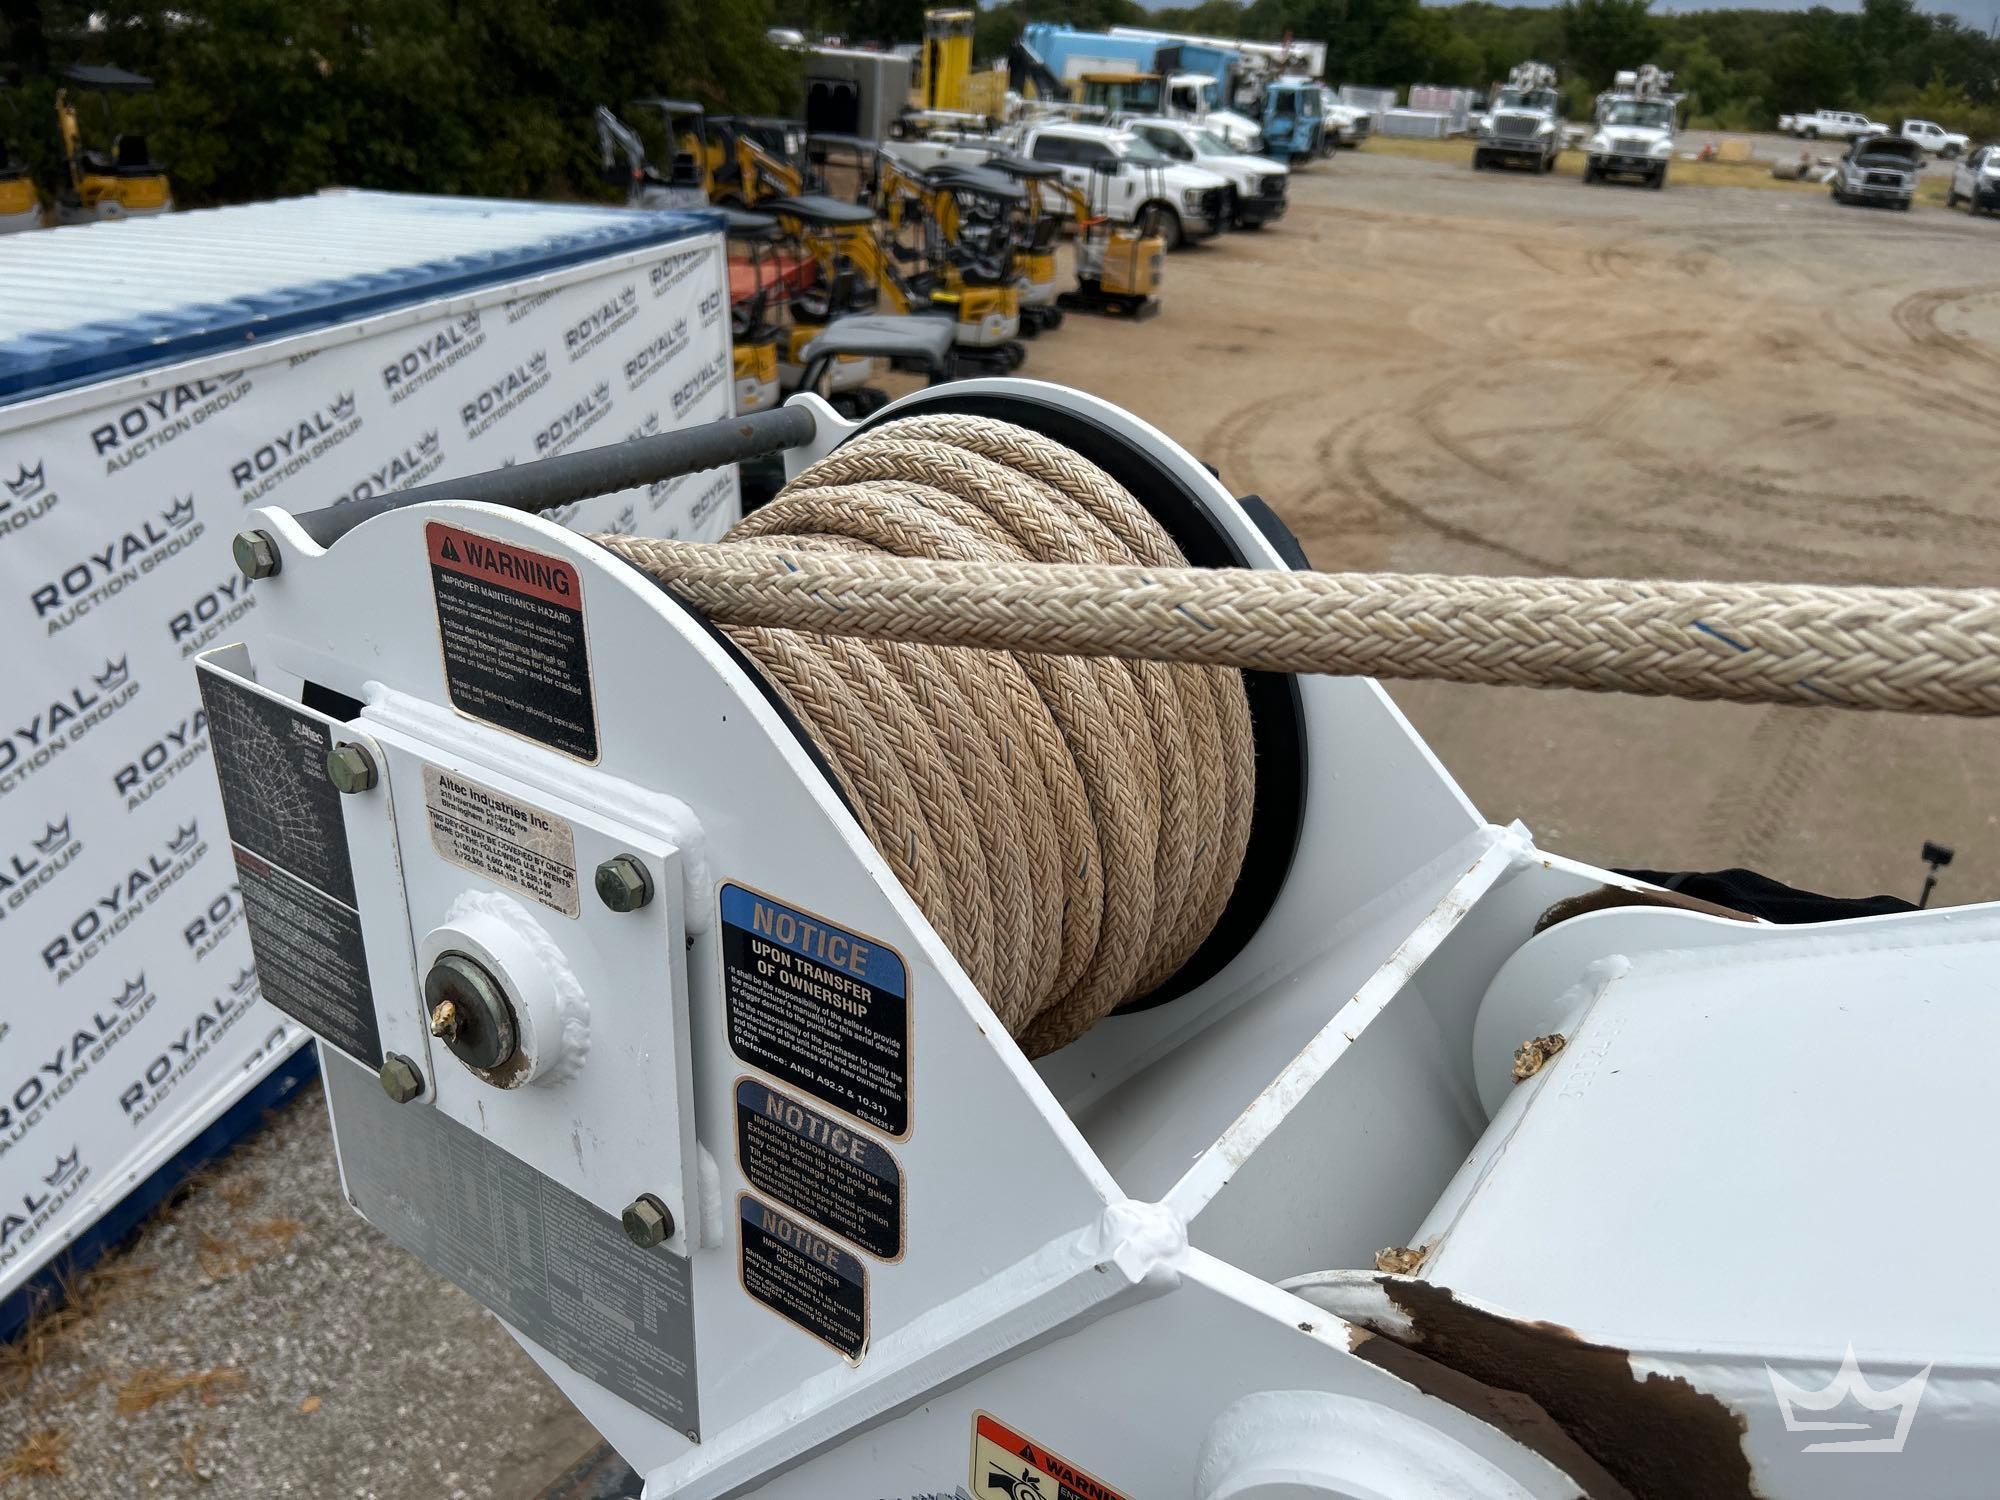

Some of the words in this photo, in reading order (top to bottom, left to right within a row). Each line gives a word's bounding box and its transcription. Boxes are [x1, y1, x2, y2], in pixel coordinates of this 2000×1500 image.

[382, 325, 463, 389] ROYAL
[564, 297, 623, 349] ROYAL
[624, 329, 676, 380] ROYAL
[90, 381, 217, 455] ROYAL
[106, 415, 191, 476] AUCTION
[192, 380, 253, 425] GROUP
[461, 365, 532, 425] ROYAL
[535, 398, 597, 453] ROYAL
[231, 412, 332, 489] ROYAL
[242, 451, 312, 505] AUCTION
[313, 416, 363, 460] GROUP
[31, 521, 168, 618] ROYAL
[48, 566, 138, 636] AUCTION
[140, 522, 205, 576] GROUP
[441, 573, 479, 594] IMPROPER
[480, 586, 535, 612] MAINTENANCE
[537, 604, 570, 623] HAZARD
[462, 540, 570, 596] WARNING
[182, 594, 256, 659] AUCTION
[438, 591, 457, 604] Death
[467, 600, 492, 615] serious
[493, 608, 512, 624] injury
[514, 616, 534, 629] could
[535, 623, 556, 637] result
[557, 630, 574, 643] from
[443, 618, 463, 631] Follow
[464, 625, 486, 640] derrick
[530, 648, 555, 663] Manual
[69, 681, 140, 741] GROUP
[128, 738, 209, 813] AUCTION
[438, 774, 466, 796] Altec
[470, 787, 527, 823] Industries
[530, 812, 552, 833] Inc.
[8, 839, 83, 911] GROUP
[429, 810, 443, 823] THIS
[444, 817, 469, 834] DEVICE
[470, 828, 485, 841] MAY
[486, 835, 496, 846] BE
[498, 840, 532, 862] COVERED
[534, 856, 544, 867] BY
[545, 861, 561, 874] ONE
[563, 869, 573, 880] OR
[454, 831, 463, 840] OF
[464, 835, 478, 847] THE
[479, 842, 521, 866] FOLLOWING
[538, 868, 570, 888] PATENTS
[41, 855, 172, 969] ROYAL
[57, 900, 144, 985] AUCTION
[145, 840, 208, 903] GROUP
[751, 900, 868, 978] NOTICE
[752, 939, 790, 968] UPON
[794, 957, 871, 1004] TRANSFER
[757, 959, 775, 979] OF
[779, 969, 867, 1020] OWNERSHIP
[90, 992, 157, 1065] GROUP
[731, 975, 741, 986] the
[742, 980, 790, 1009] manufacturer's
[792, 1003, 826, 1026] manual(s)
[827, 1018, 837, 1030] for
[839, 1024, 852, 1036] this
[854, 1030, 873, 1046] aerial
[875, 1040, 898, 1057] device
[732, 985, 738, 994] or
[740, 988, 760, 1005] digger
[761, 998, 784, 1015] derrick
[786, 1009, 792, 1019] to
[794, 1013, 804, 1024] the
[806, 1019, 842, 1043] purchaser.
[736, 968, 752, 982] shall
[753, 976, 761, 985] be
[763, 980, 773, 991] the
[774, 985, 820, 1013] responsibility
[822, 1007, 829, 1016] of
[830, 1010, 841, 1022] the
[843, 1016, 862, 1031] seller
[864, 1026, 871, 1035] to
[873, 1030, 900, 1050] provide
[738, 1000, 743, 1008] is
[745, 1003, 755, 1014] the
[757, 1008, 801, 1036] responsibility
[802, 1030, 809, 1039] of
[811, 1034, 822, 1045] the
[823, 1040, 857, 1063] purchaser
[860, 1056, 866, 1066] to
[868, 1060, 888, 1077] notify
[891, 1070, 902, 1082] the
[118, 997, 234, 1114] ROYAL
[132, 1045, 209, 1127] AUCTION
[734, 1034, 787, 1067] (Reference:
[790, 1061, 813, 1079] ANSI
[816, 1074, 843, 1094] A92.2
[847, 1088, 854, 1099] &
[857, 1093, 887, 1116] 10.31)
[747, 1121, 787, 1151] Extending
[789, 1143, 812, 1163] boom
[814, 1156, 825, 1172] tip
[828, 1163, 844, 1180] into
[846, 1173, 865, 1193] pole
[867, 1184, 892, 1207] guide
[747, 1133, 763, 1149] may
[766, 1142, 789, 1161] cause
[791, 1155, 824, 1181] damage
[826, 1174, 835, 1185] to
[837, 1180, 856, 1197] unit.
[753, 1114, 797, 1144] IMPROPER
[800, 1138, 825, 1158] BOOM
[828, 1153, 877, 1186] OPERATION
[764, 1091, 867, 1167] NOTICE
[20, 1166, 91, 1251] GROUP
[761, 1207, 839, 1271] NOTICE
[763, 1236, 804, 1267] IMPROPER
[807, 1262, 839, 1287] DIGGER
[776, 1252, 822, 1287] OPERATION
